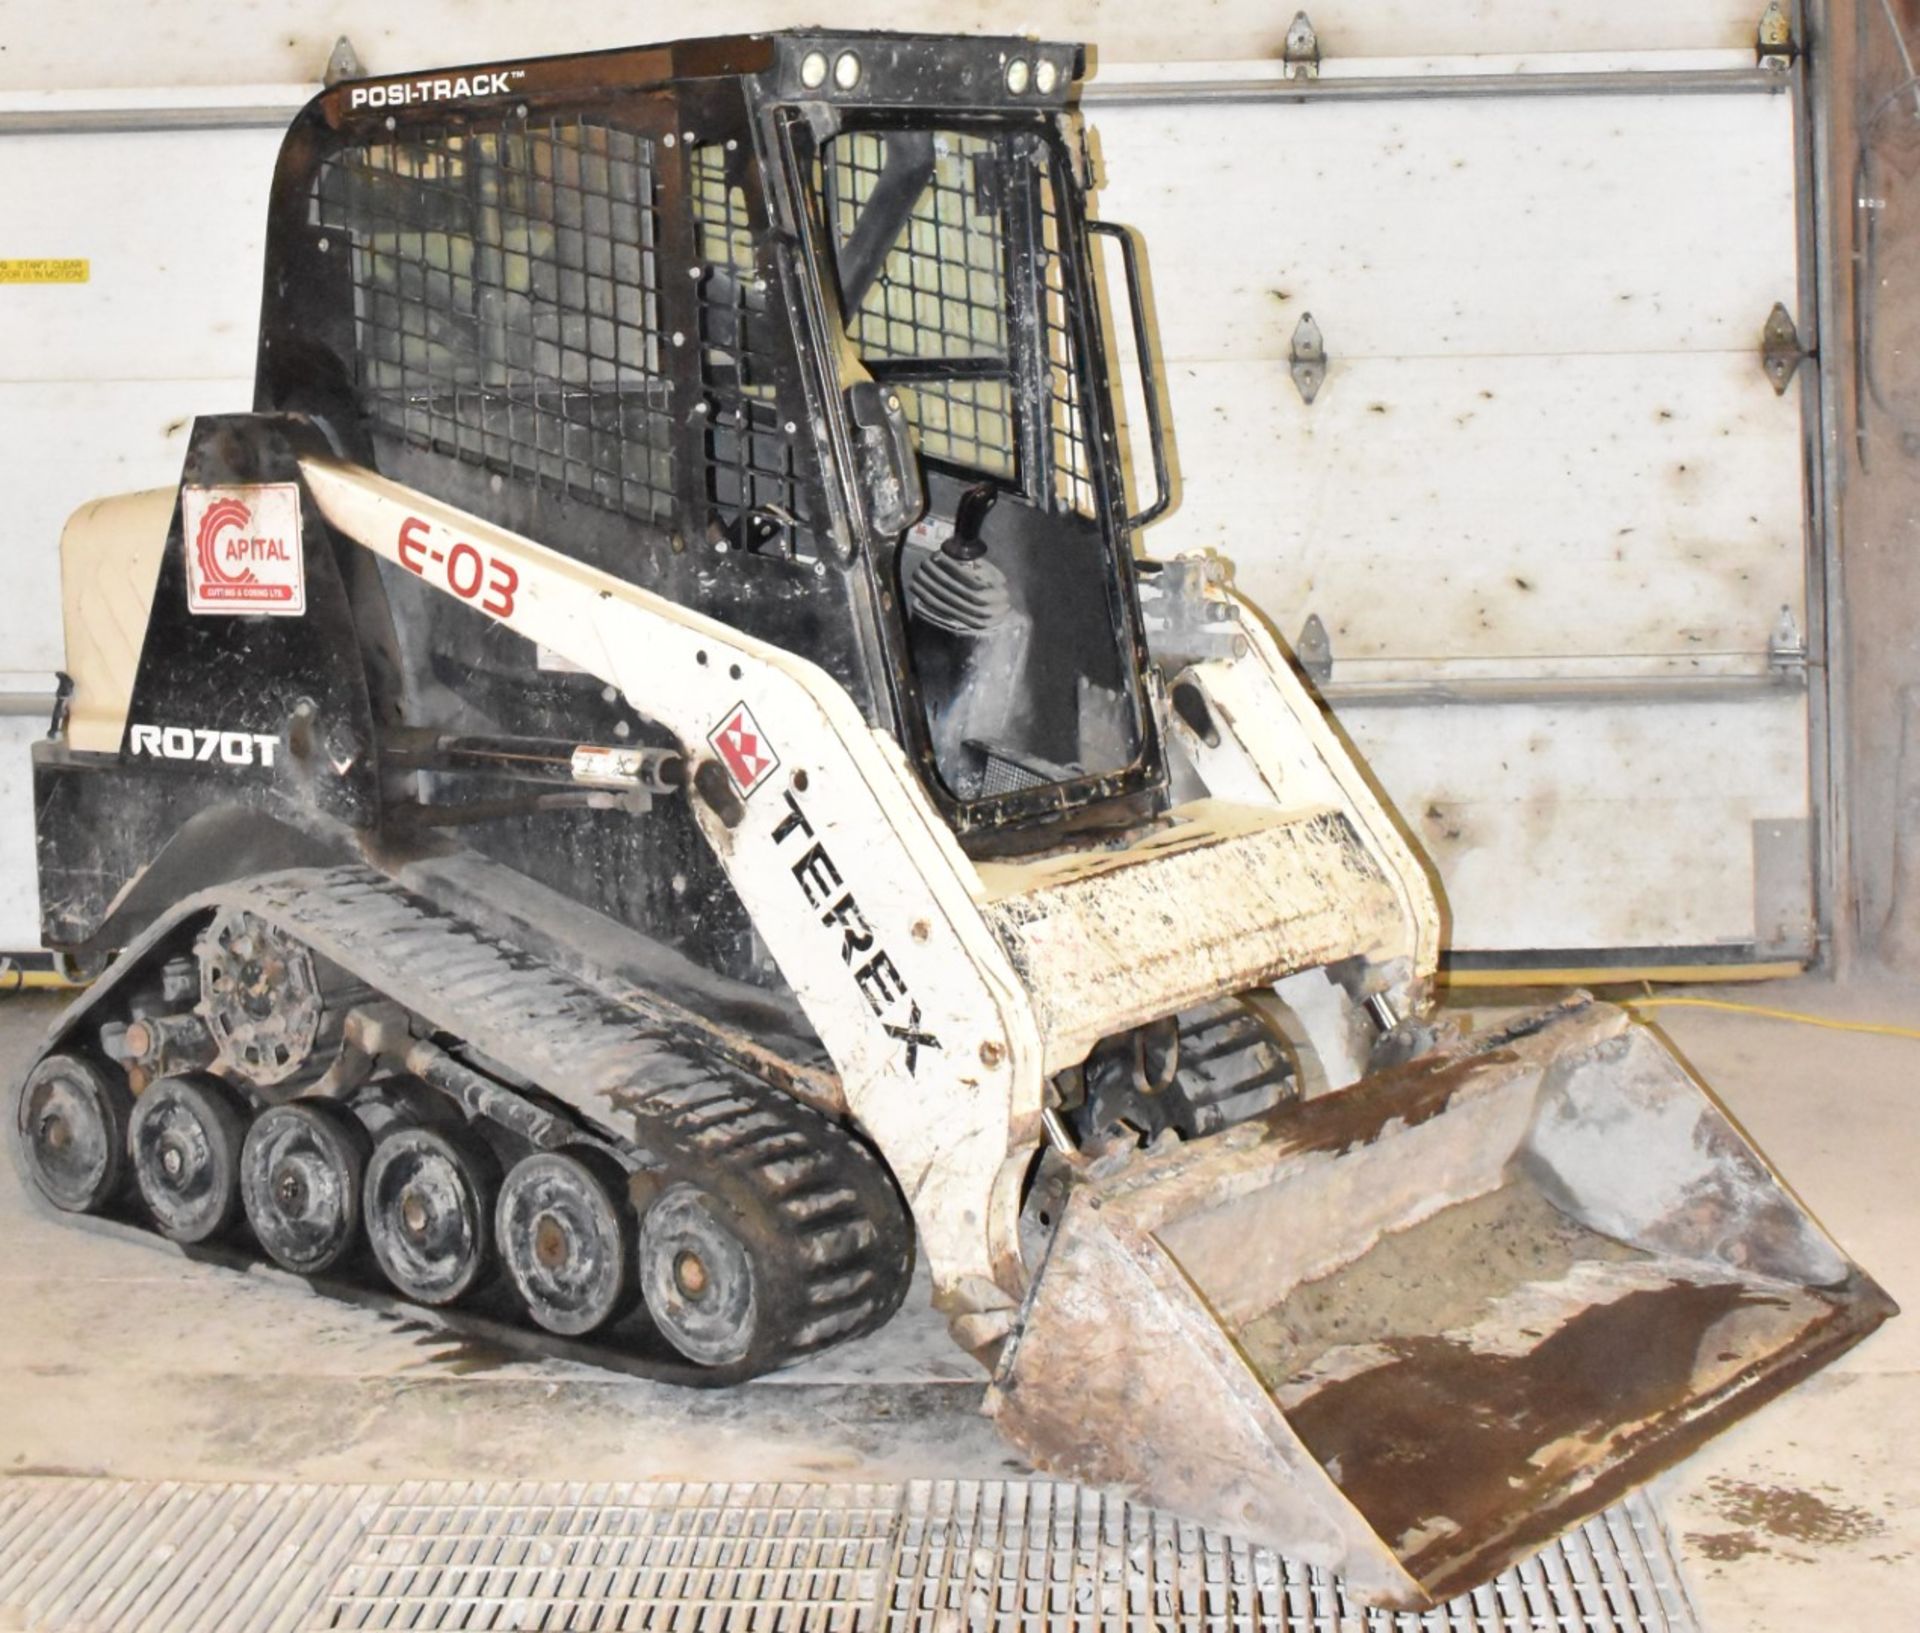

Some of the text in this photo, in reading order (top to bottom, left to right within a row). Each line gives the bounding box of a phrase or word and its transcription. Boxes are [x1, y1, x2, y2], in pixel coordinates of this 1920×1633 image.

[52, 260, 83, 271] CLEAR
[398, 516, 518, 618] E-03
[130, 723, 281, 767] R070T
[771, 789, 942, 1078] TEREX
